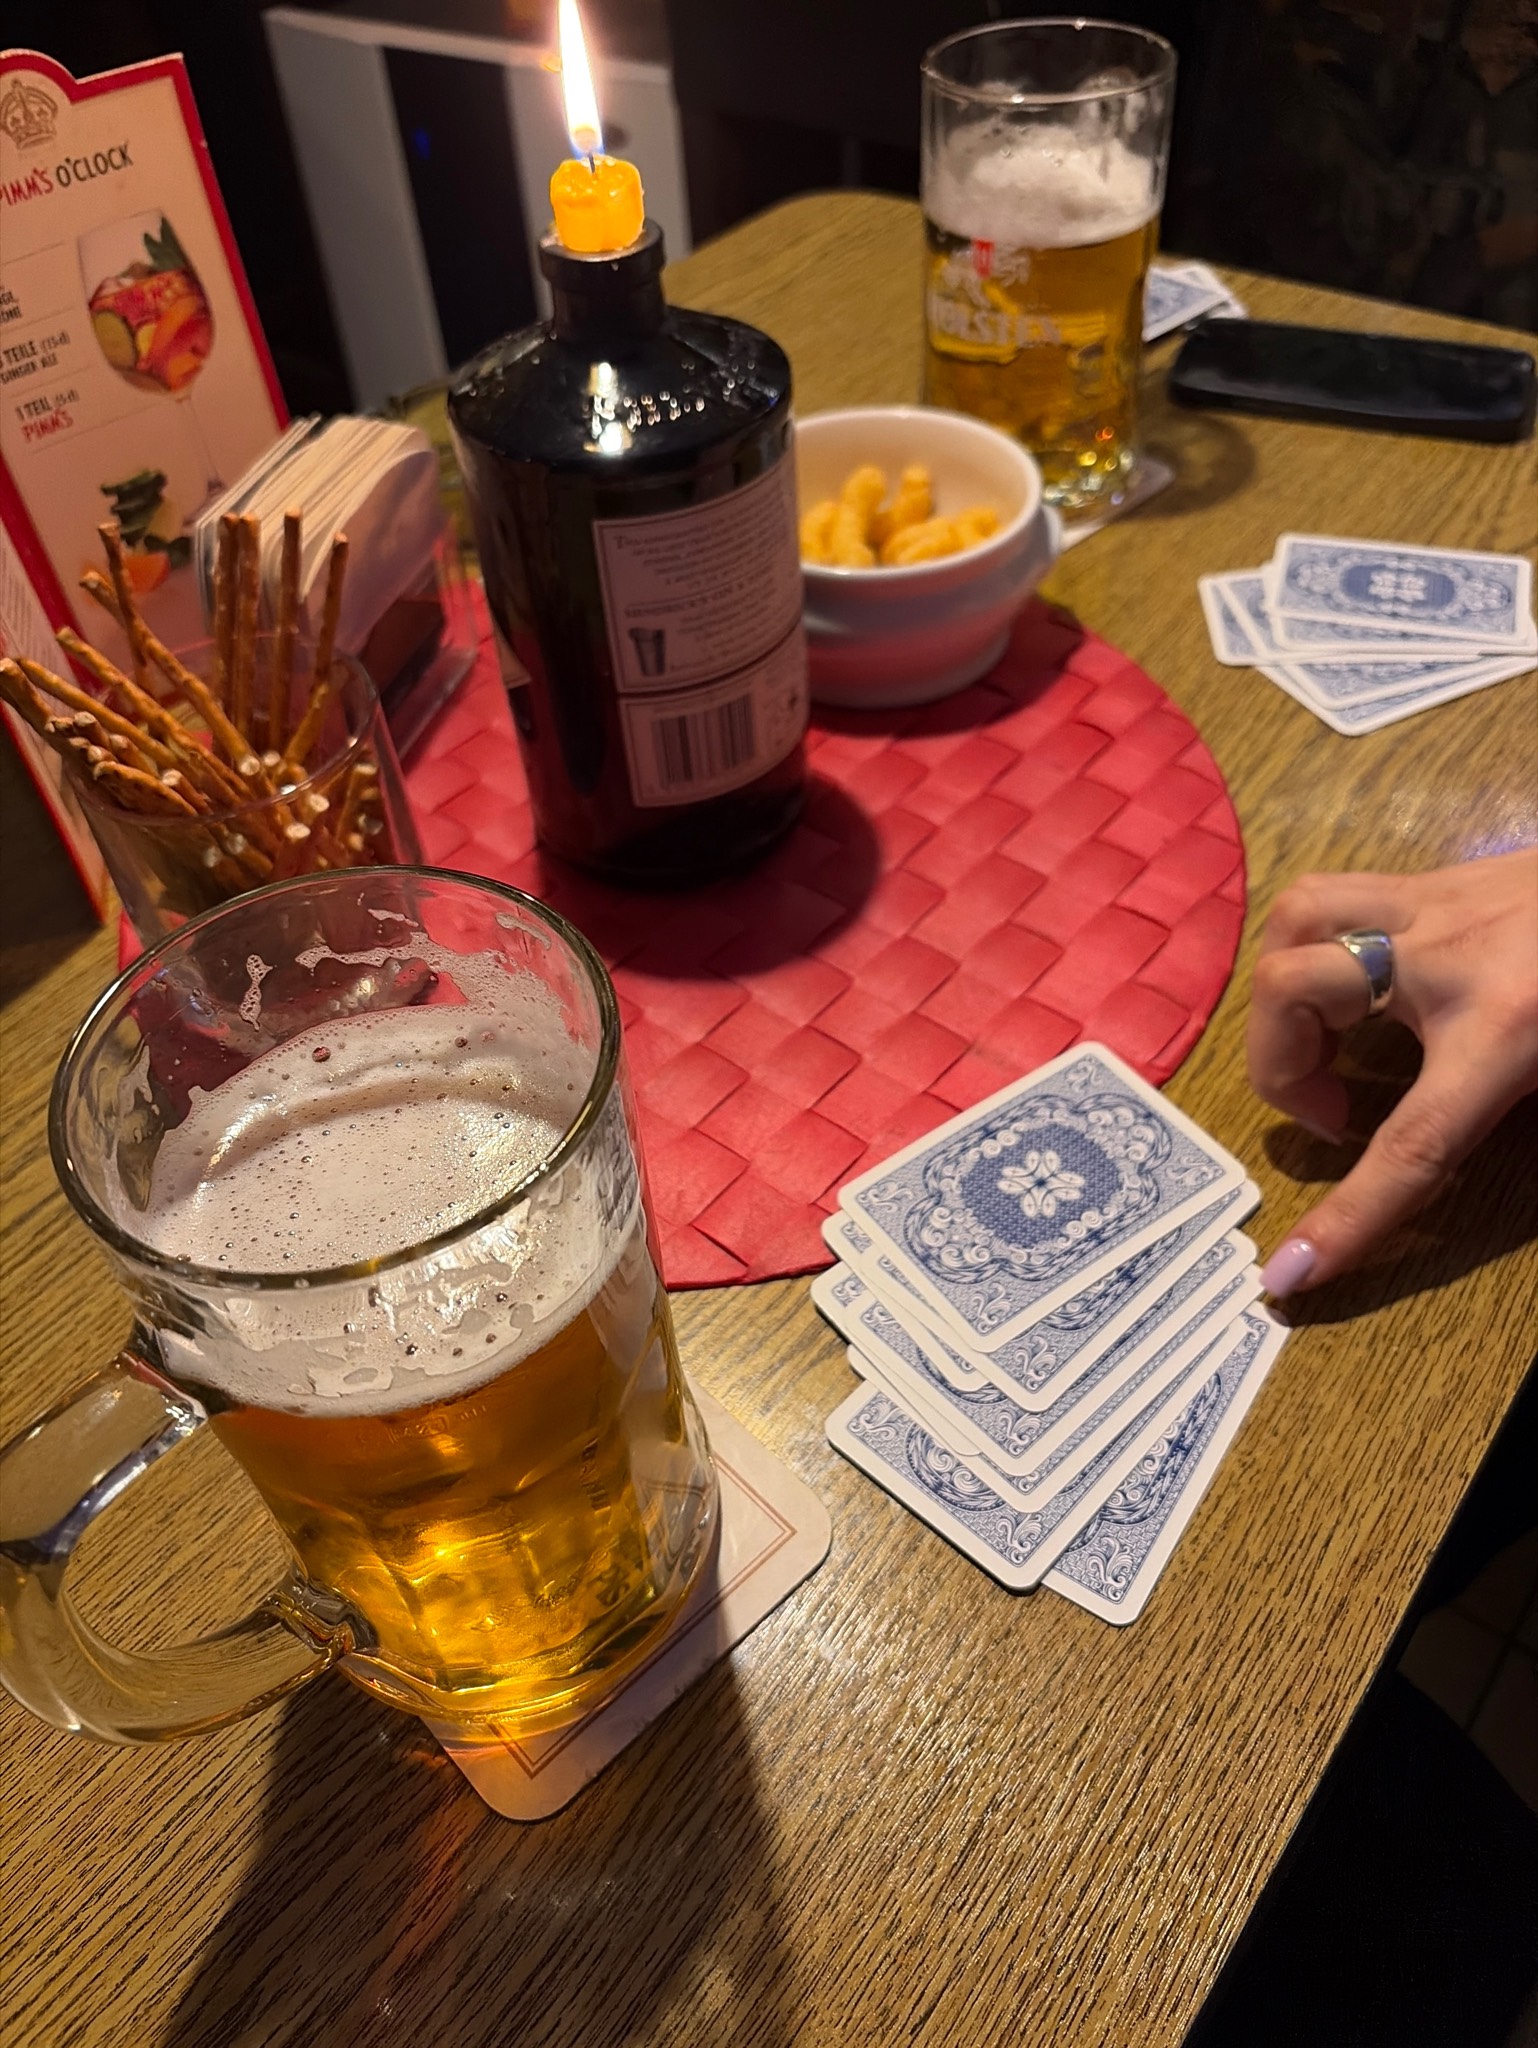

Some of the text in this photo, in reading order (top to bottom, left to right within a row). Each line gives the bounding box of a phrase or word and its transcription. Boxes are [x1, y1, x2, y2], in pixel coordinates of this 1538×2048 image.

[0, 142, 133, 206] IMM'S O'CLOCK
[24, 396, 52, 418] TEIL
